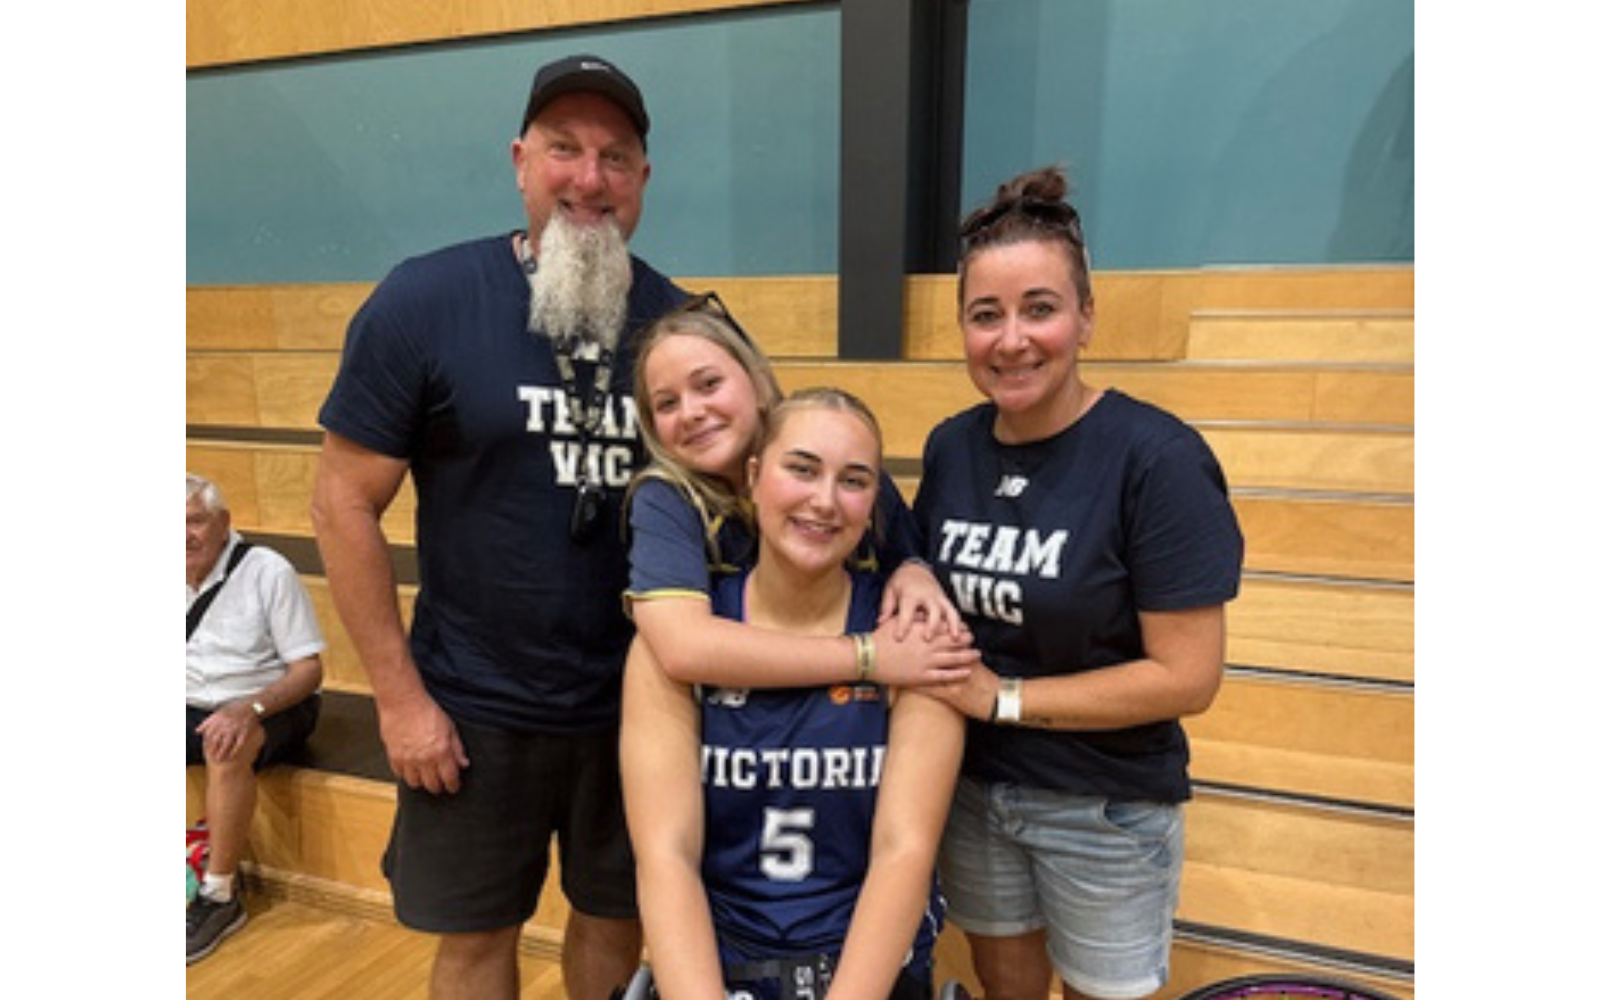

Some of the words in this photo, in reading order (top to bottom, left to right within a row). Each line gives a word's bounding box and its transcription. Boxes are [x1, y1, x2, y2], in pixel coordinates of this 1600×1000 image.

[551, 441, 632, 487] VIC
[939, 519, 1068, 579] TEAM
[951, 573, 1023, 625] VIC
[758, 807, 815, 880] 5
